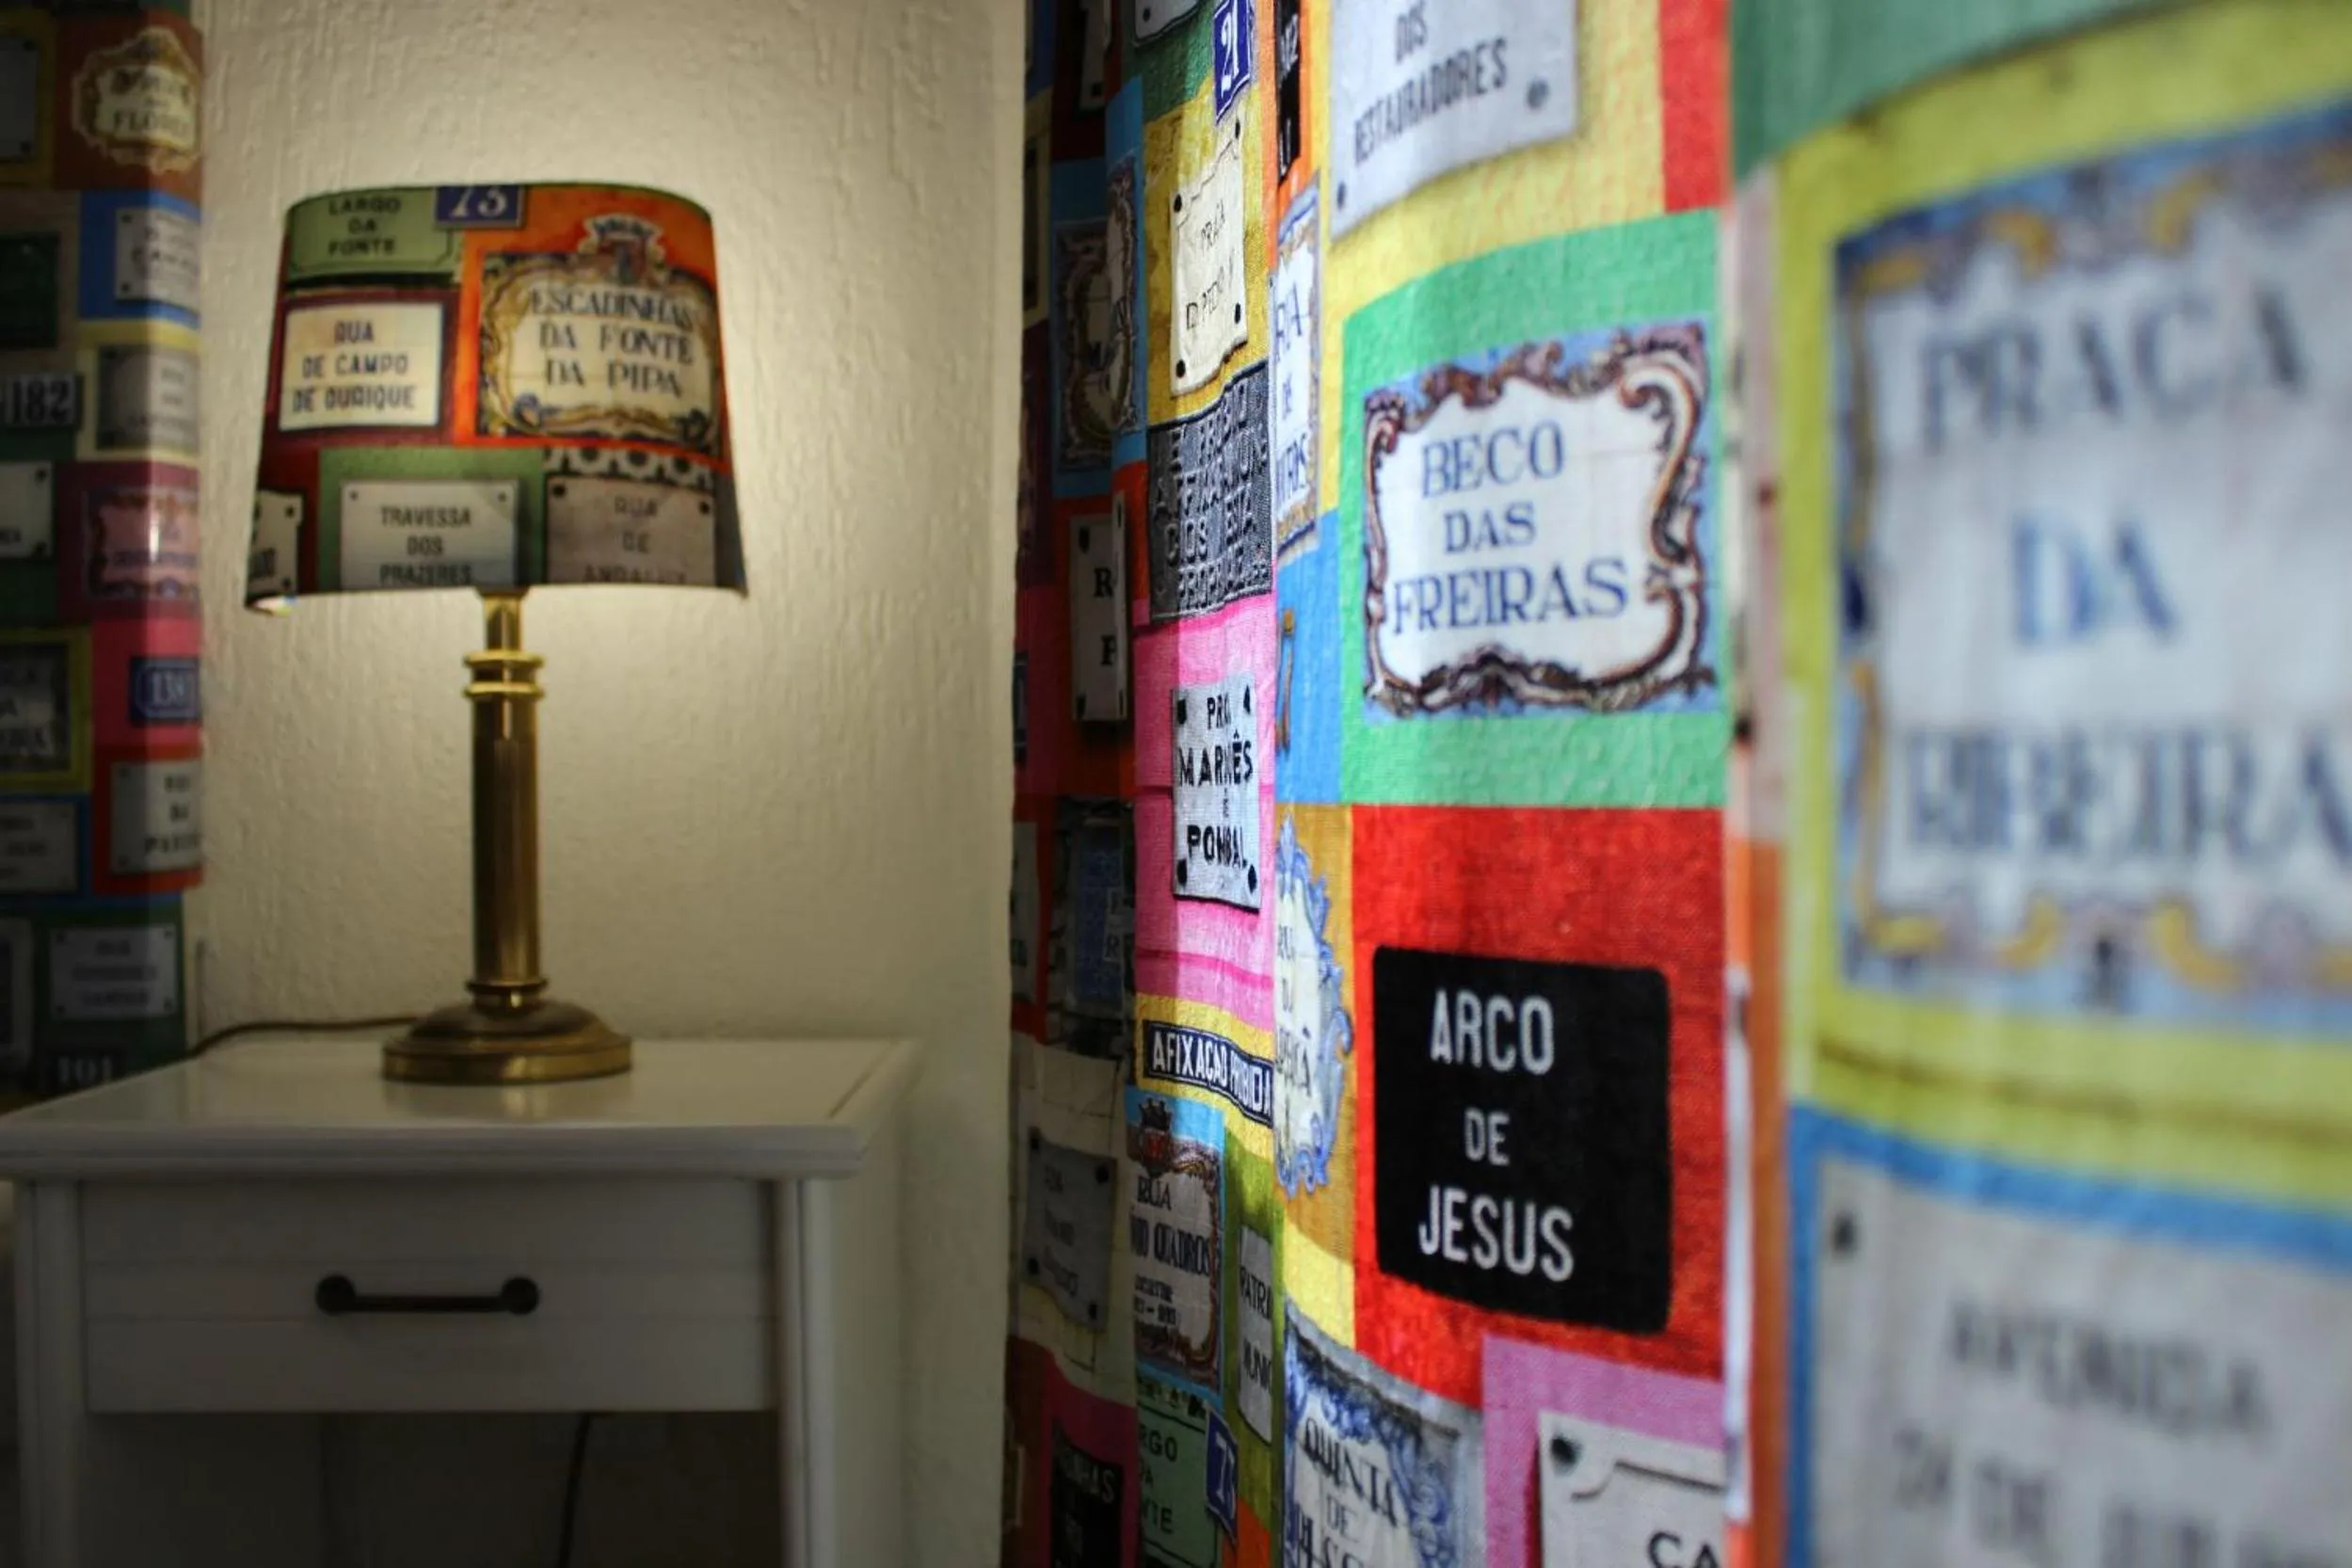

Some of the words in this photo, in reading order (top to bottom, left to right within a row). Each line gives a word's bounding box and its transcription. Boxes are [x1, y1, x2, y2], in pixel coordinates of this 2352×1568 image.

[328, 196, 403, 216] LARGO
[347, 217, 377, 234] DA
[328, 237, 396, 256] FONTE
[538, 320, 578, 351] DA
[600, 322, 696, 366] FONTE
[302, 353, 326, 378] DE
[334, 352, 409, 376] CAMPO
[546, 358, 586, 388] DA
[606, 359, 683, 399] PIPA
[293, 387, 317, 414] DE
[324, 384, 417, 411] OURIQUE
[1420, 419, 1565, 500] BECO
[379, 505, 472, 528] TRAVESSA
[1443, 506, 1538, 556] DAS
[406, 535, 443, 557] DOS
[378, 565, 472, 587] PRAZERES
[1392, 557, 1631, 637] FREIRAS
[2010, 513, 2182, 649] DA
[1430, 987, 1556, 1076] ARCO
[1463, 1107, 1511, 1167] DE
[1137, 1176, 1172, 1211] RUA
[1417, 1184, 1576, 1283] JESUS
[1304, 1416, 1398, 1528] QUINTA
[1326, 1493, 1361, 1544] DE
